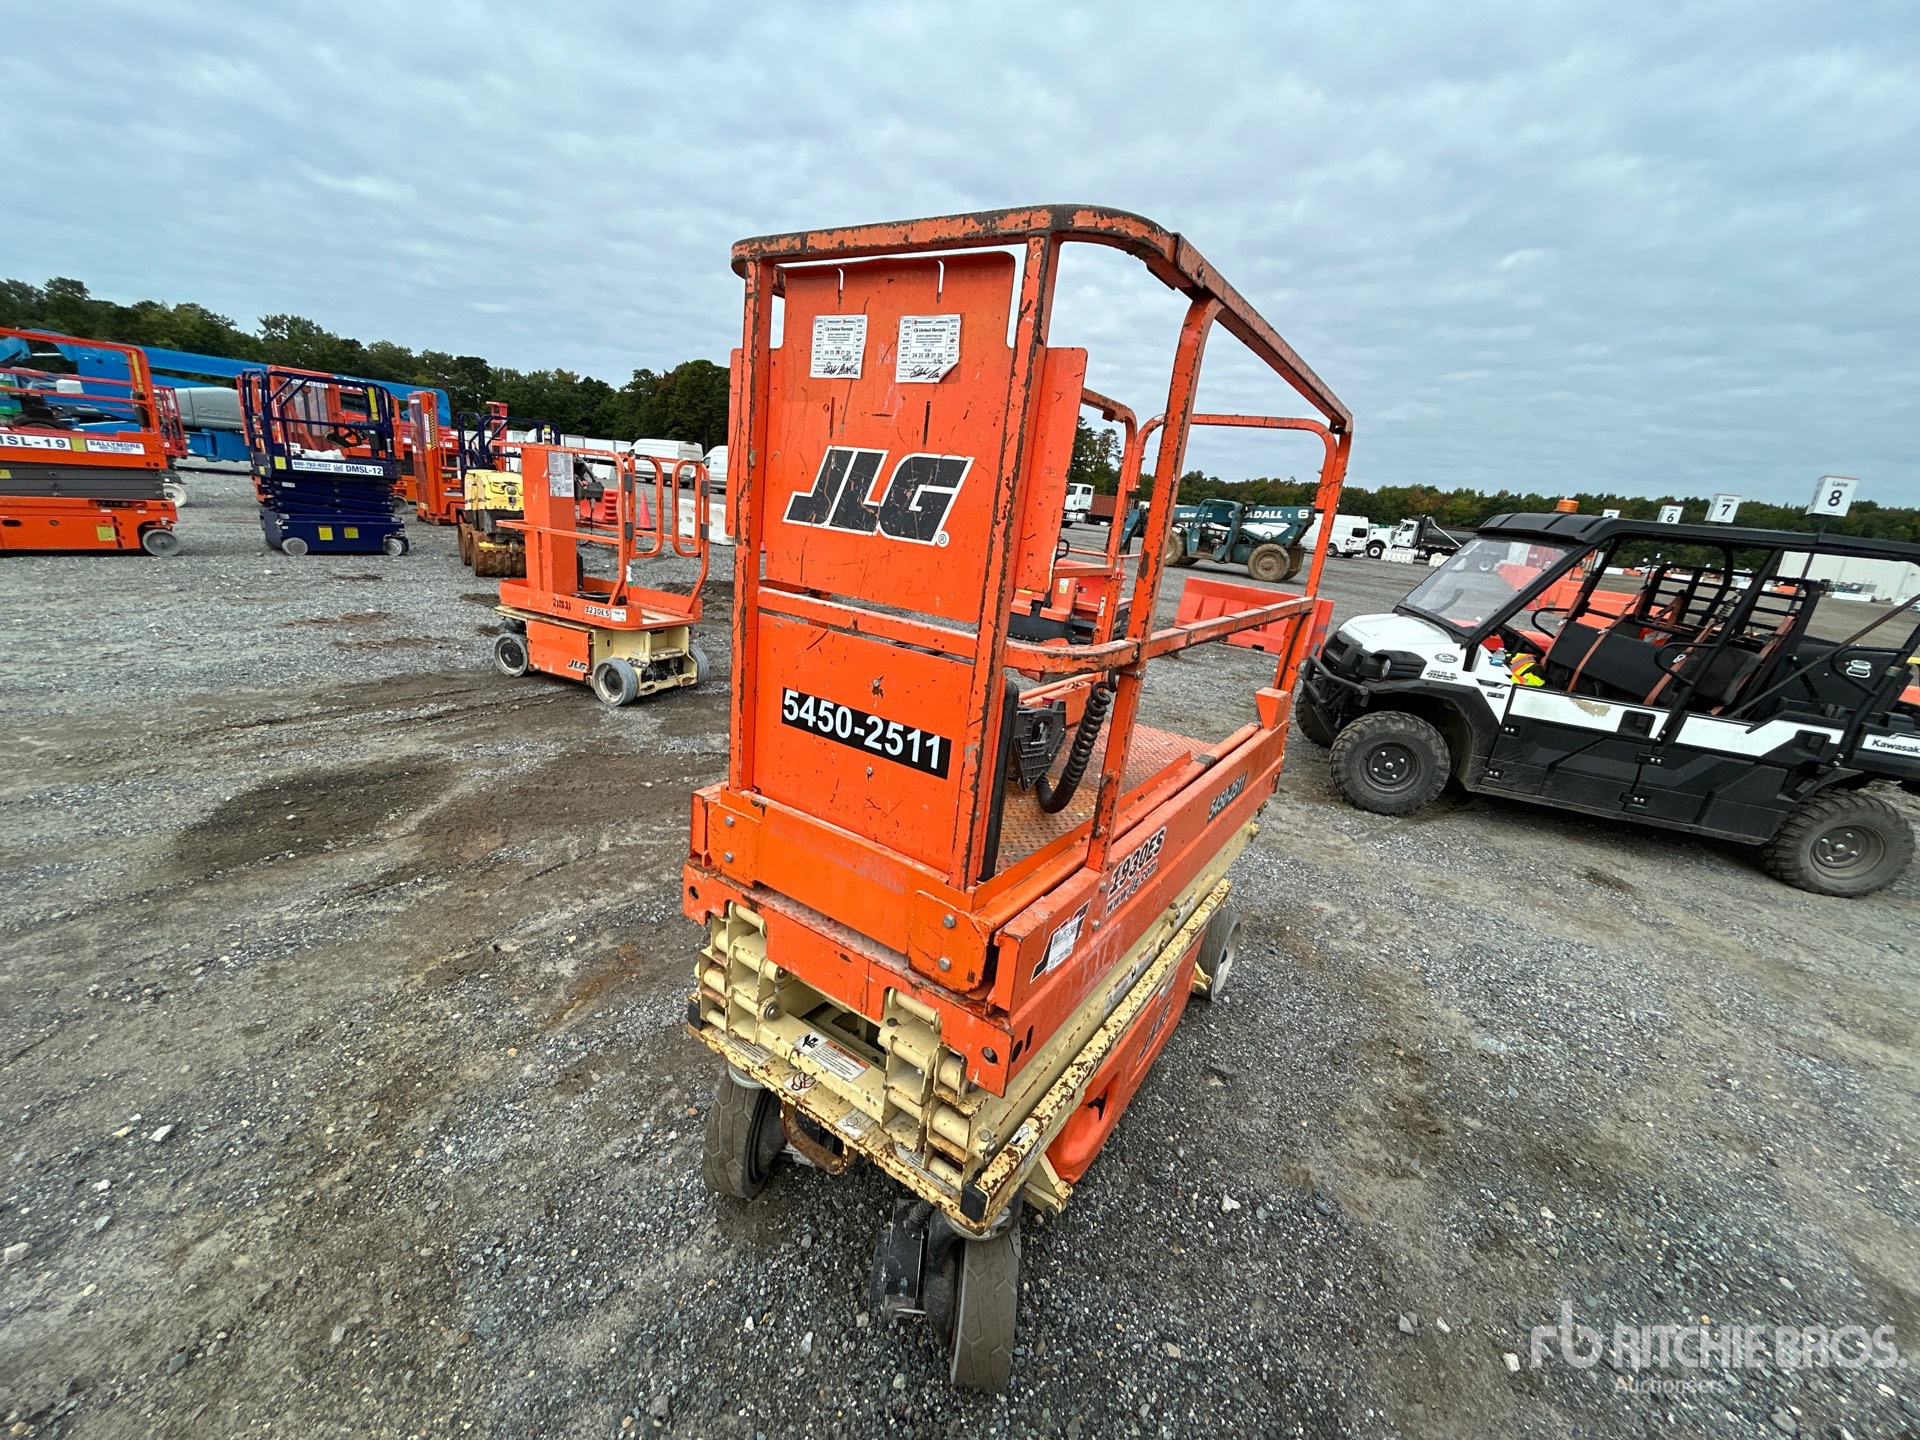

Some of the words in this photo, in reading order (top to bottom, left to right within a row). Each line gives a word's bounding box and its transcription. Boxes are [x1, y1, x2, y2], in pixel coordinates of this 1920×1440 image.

[90, 440, 141, 449] BALLYMORE
[345, 465, 382, 474] DMSL-12
[783, 446, 974, 545] JLG
[1828, 490, 1843, 507] 8
[1721, 504, 1731, 516] 7
[1667, 513, 1674, 522] 6
[585, 606, 610, 617] 1230ES
[568, 660, 588, 672] JLG
[782, 688, 941, 770] 5450-2511
[1108, 828, 1166, 897] 1930ES
